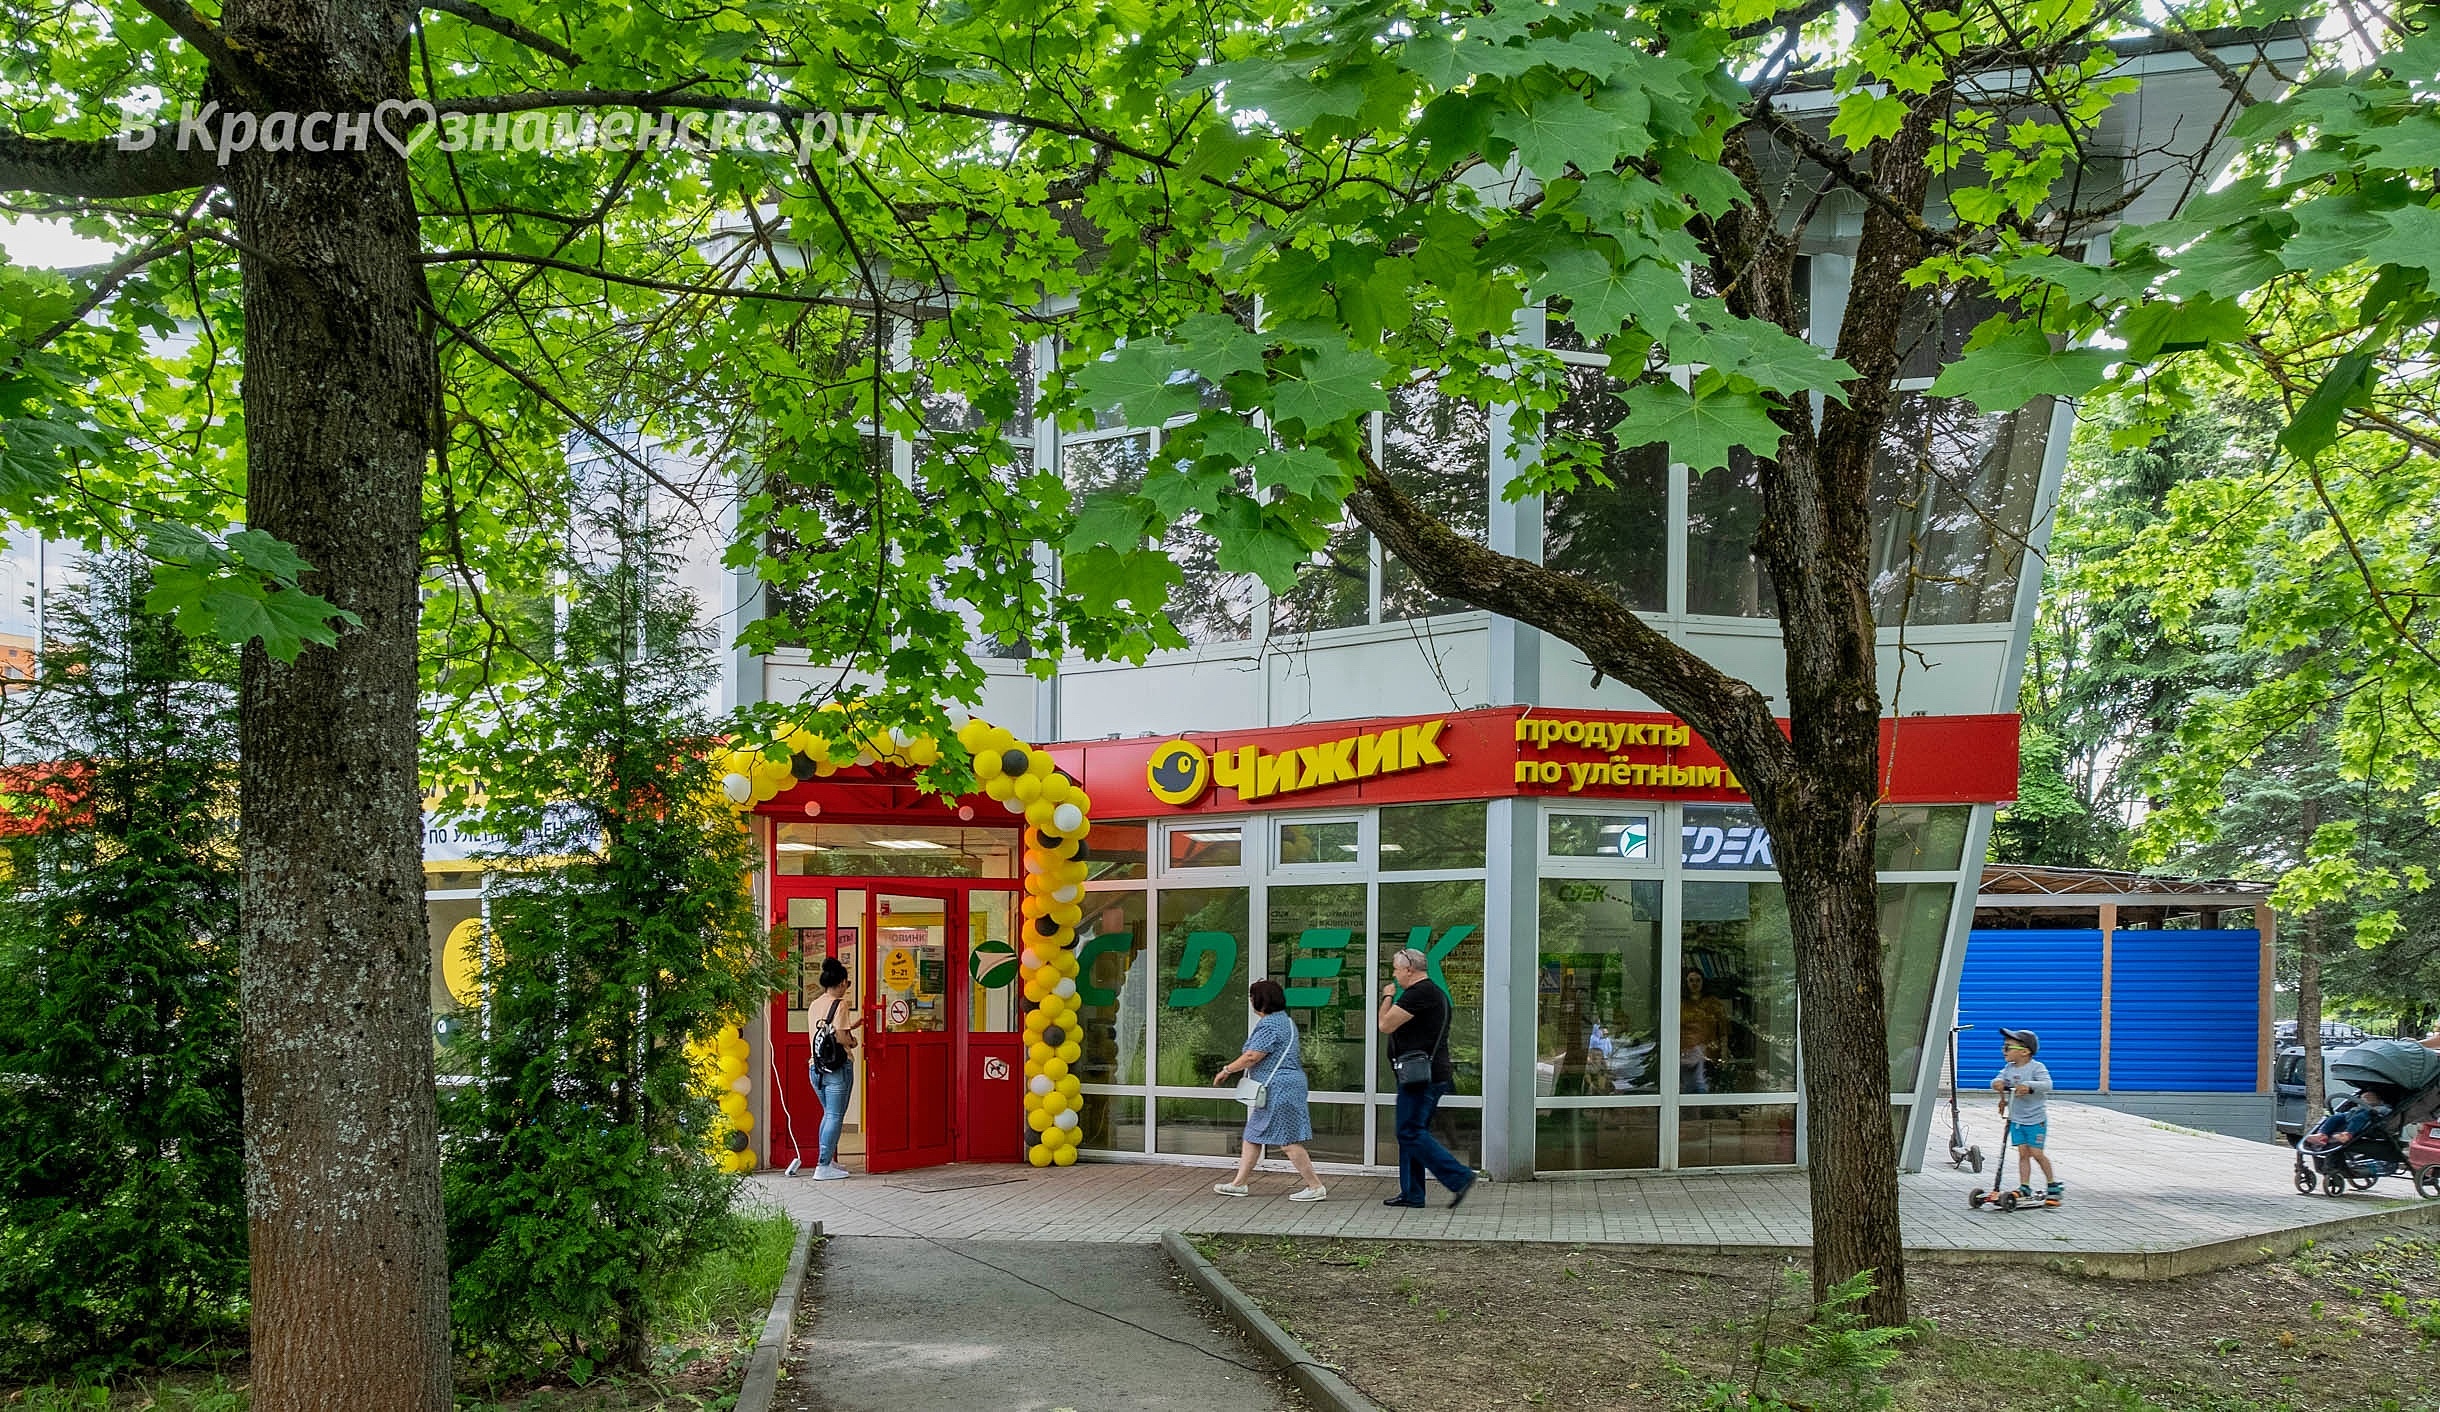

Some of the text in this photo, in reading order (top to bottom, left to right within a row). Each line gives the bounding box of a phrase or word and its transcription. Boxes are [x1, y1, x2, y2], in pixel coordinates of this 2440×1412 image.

[1516, 719, 1690, 752] продукты
[1515, 761, 1562, 783] по
[1568, 755, 1721, 792] улётным
[429, 829, 447, 844] ПО
[1075, 925, 1477, 1009] CDEK
